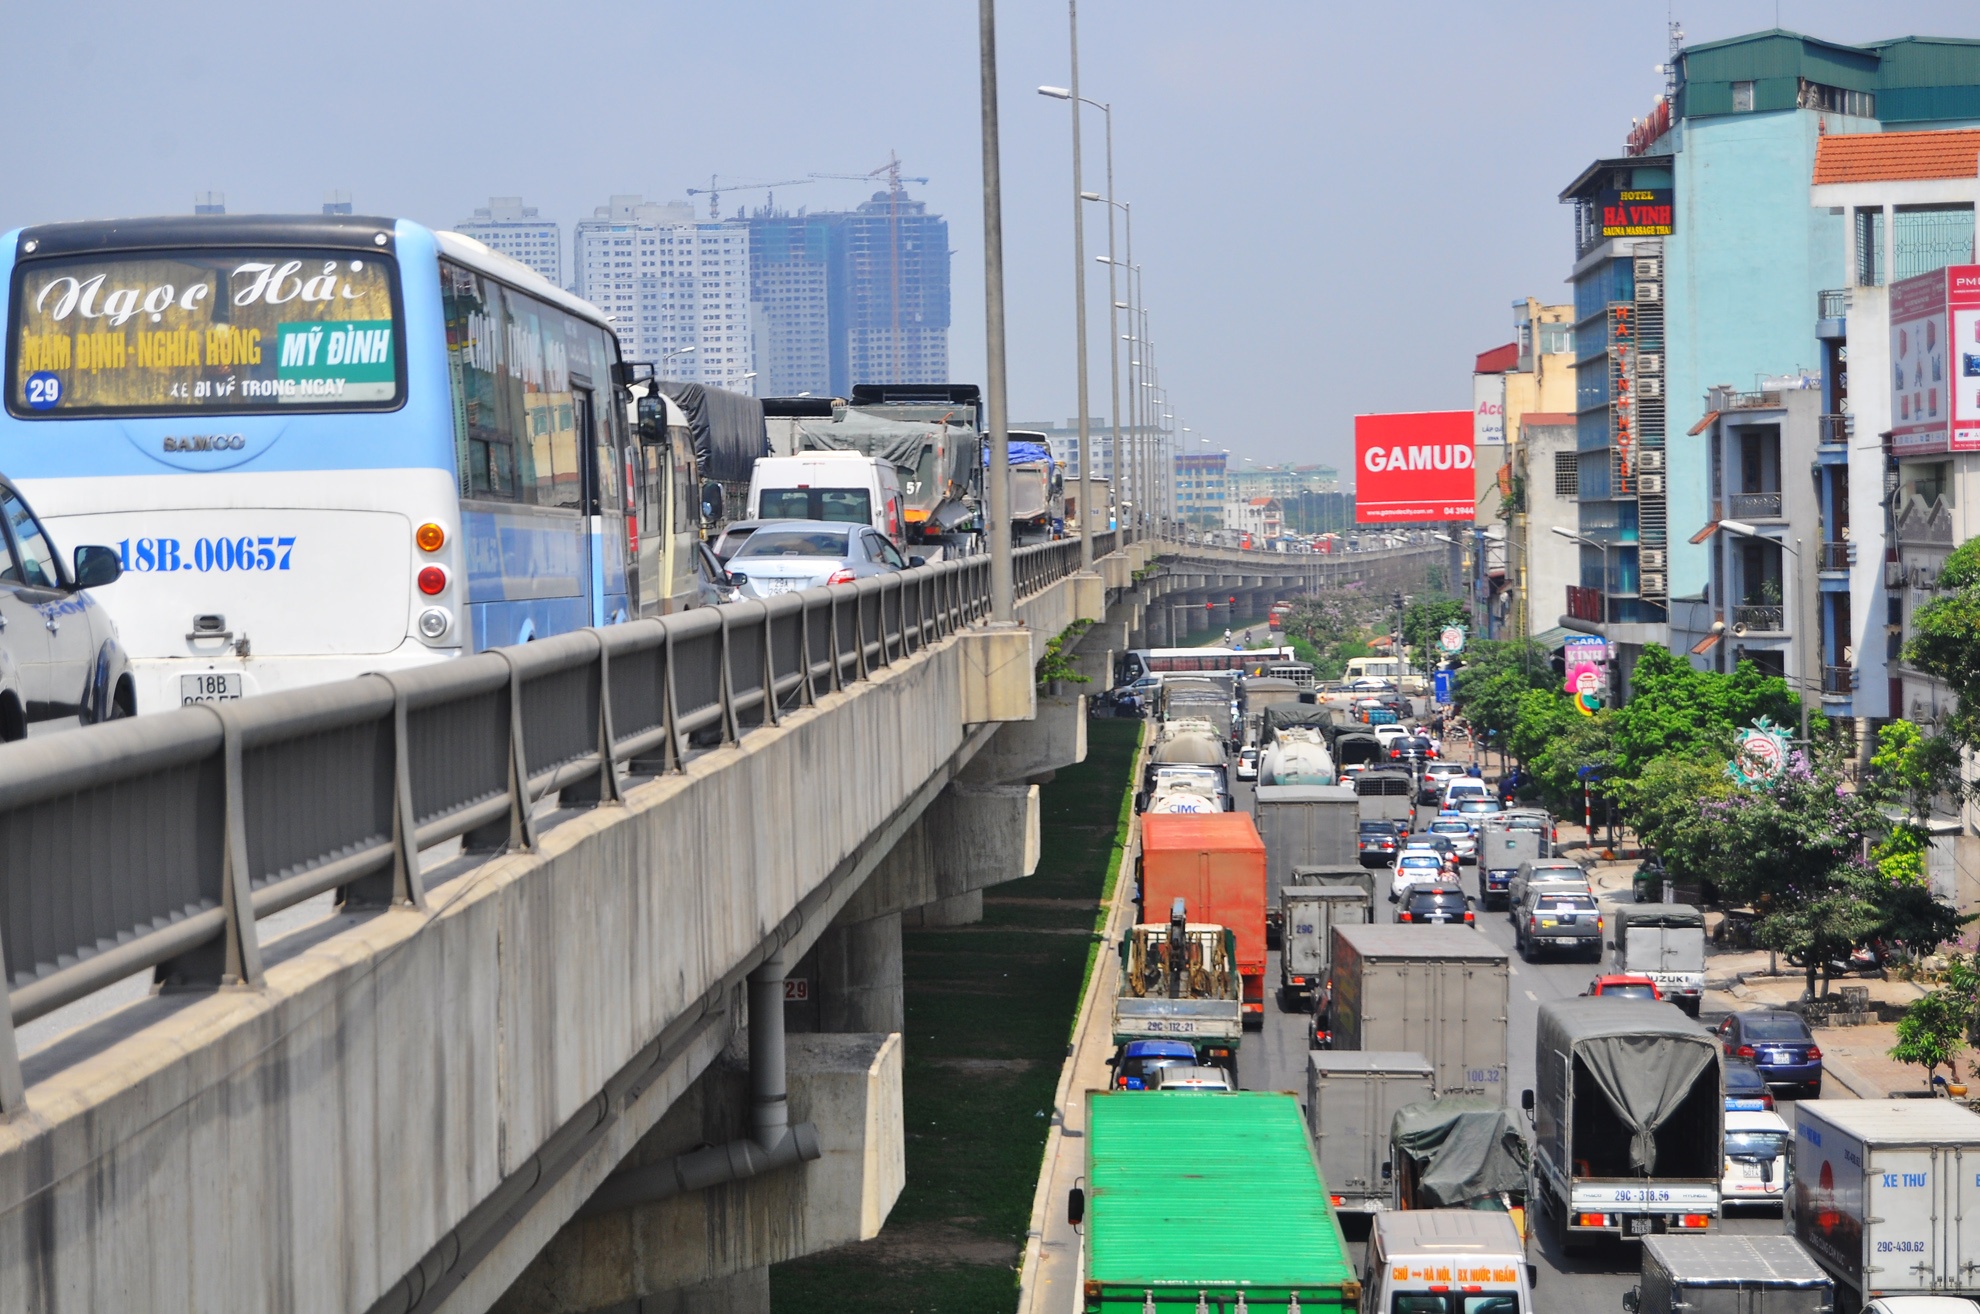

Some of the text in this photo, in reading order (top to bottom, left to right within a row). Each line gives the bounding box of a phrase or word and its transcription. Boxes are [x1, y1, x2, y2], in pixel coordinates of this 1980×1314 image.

[1620, 191, 1654, 200] HOTEL
[1603, 201, 1671, 226] HÀ VINH
[1602, 226, 1625, 236] SAUNA
[1625, 226, 1656, 236] MASSAGE
[1956, 277, 1980, 286] PM
[36, 260, 368, 326] Ngọc Hải
[25, 334, 71, 371] NAM
[76, 332, 126, 375] ĐỊNH
[137, 325, 200, 368] NGHĨA
[281, 324, 391, 367] MỸ ĐÌNH
[30, 378, 59, 402] 29
[241, 379, 296, 397] TRONG
[163, 433, 246, 452] SAMCO
[1364, 445, 1475, 472] GAMUD
[906, 481, 922, 495] 57
[1443, 507, 1454, 515] 04
[115, 536, 297, 572] 18B.00657
[197, 676, 227, 694] 18B
[1650, 975, 1689, 983] UZUKI
[785, 981, 807, 999] 29
[1883, 1172, 1927, 1188] XE THƯ
[1615, 1190, 1631, 1201] 29C
[1877, 1241, 1924, 1252] 29C-430.62
[1457, 1269, 1468, 1281] BX
